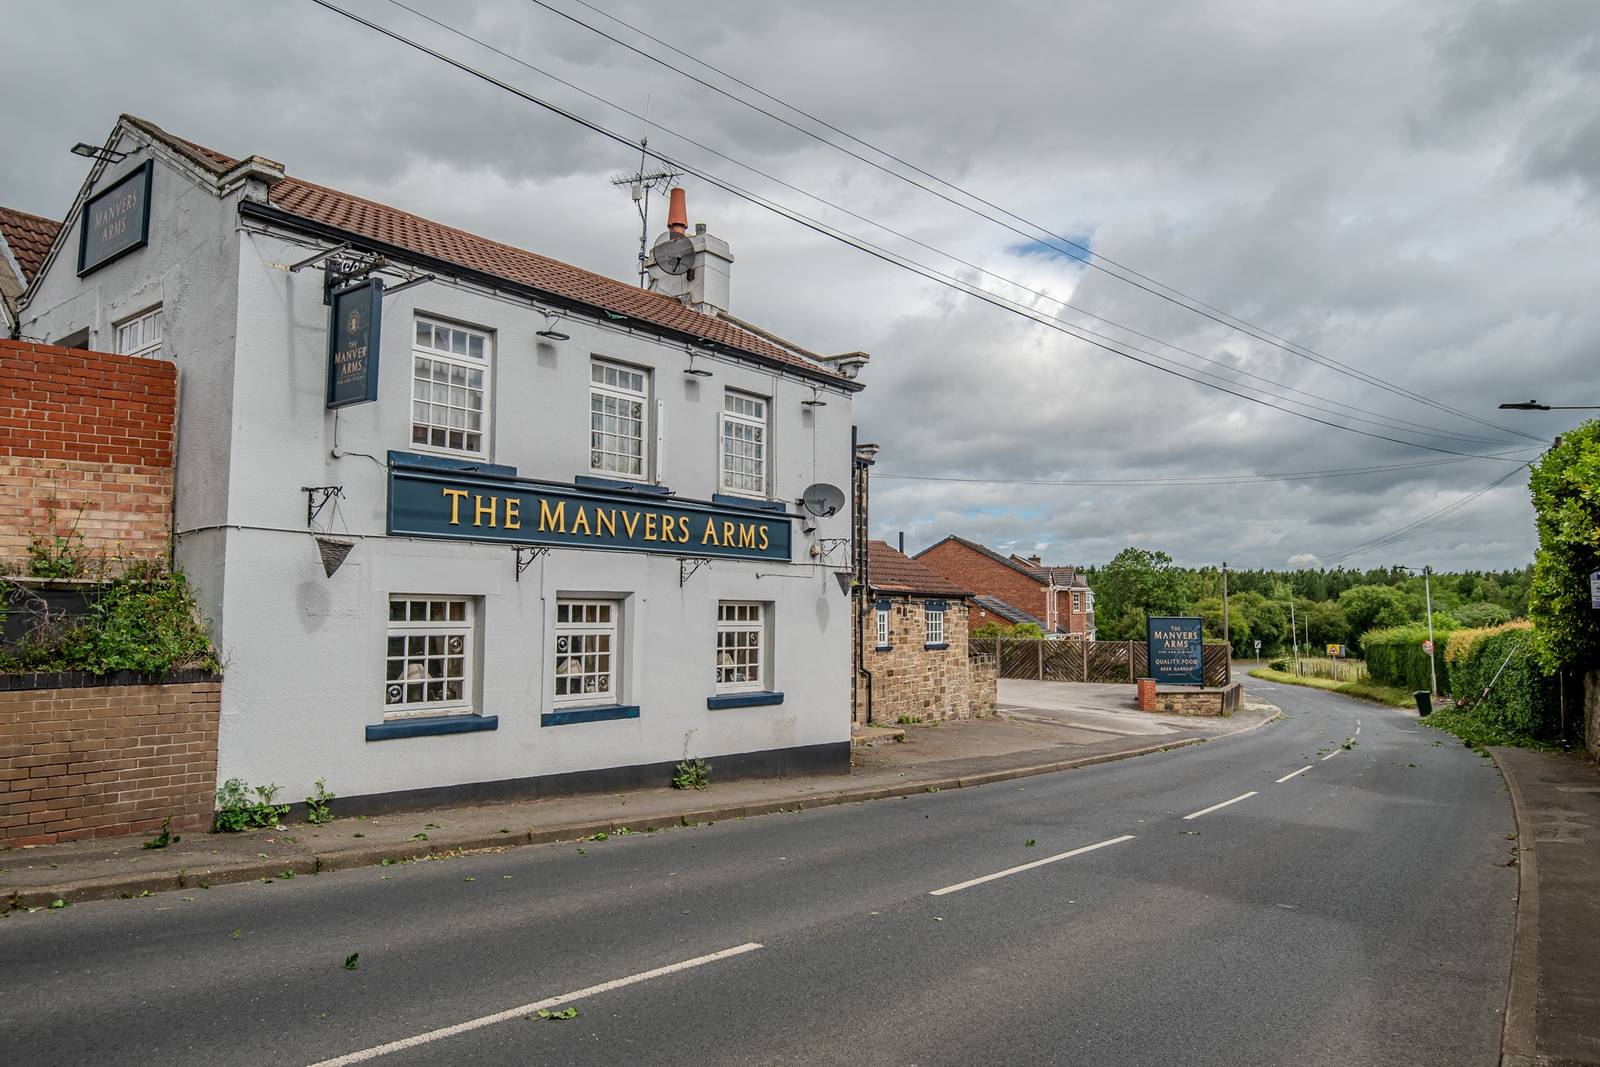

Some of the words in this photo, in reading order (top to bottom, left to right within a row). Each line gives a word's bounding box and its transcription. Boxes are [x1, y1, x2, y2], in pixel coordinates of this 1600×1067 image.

[95, 190, 137, 232] MANVERS
[103, 217, 126, 241] ARMS
[335, 346, 368, 365] MANVER
[341, 359, 362, 375] ARMS
[442, 488, 521, 529] THE
[538, 499, 690, 543] MANVERS
[701, 517, 770, 550] ARMS
[1154, 631, 1198, 639] MANVERS
[1164, 640, 1189, 648] ARMS
